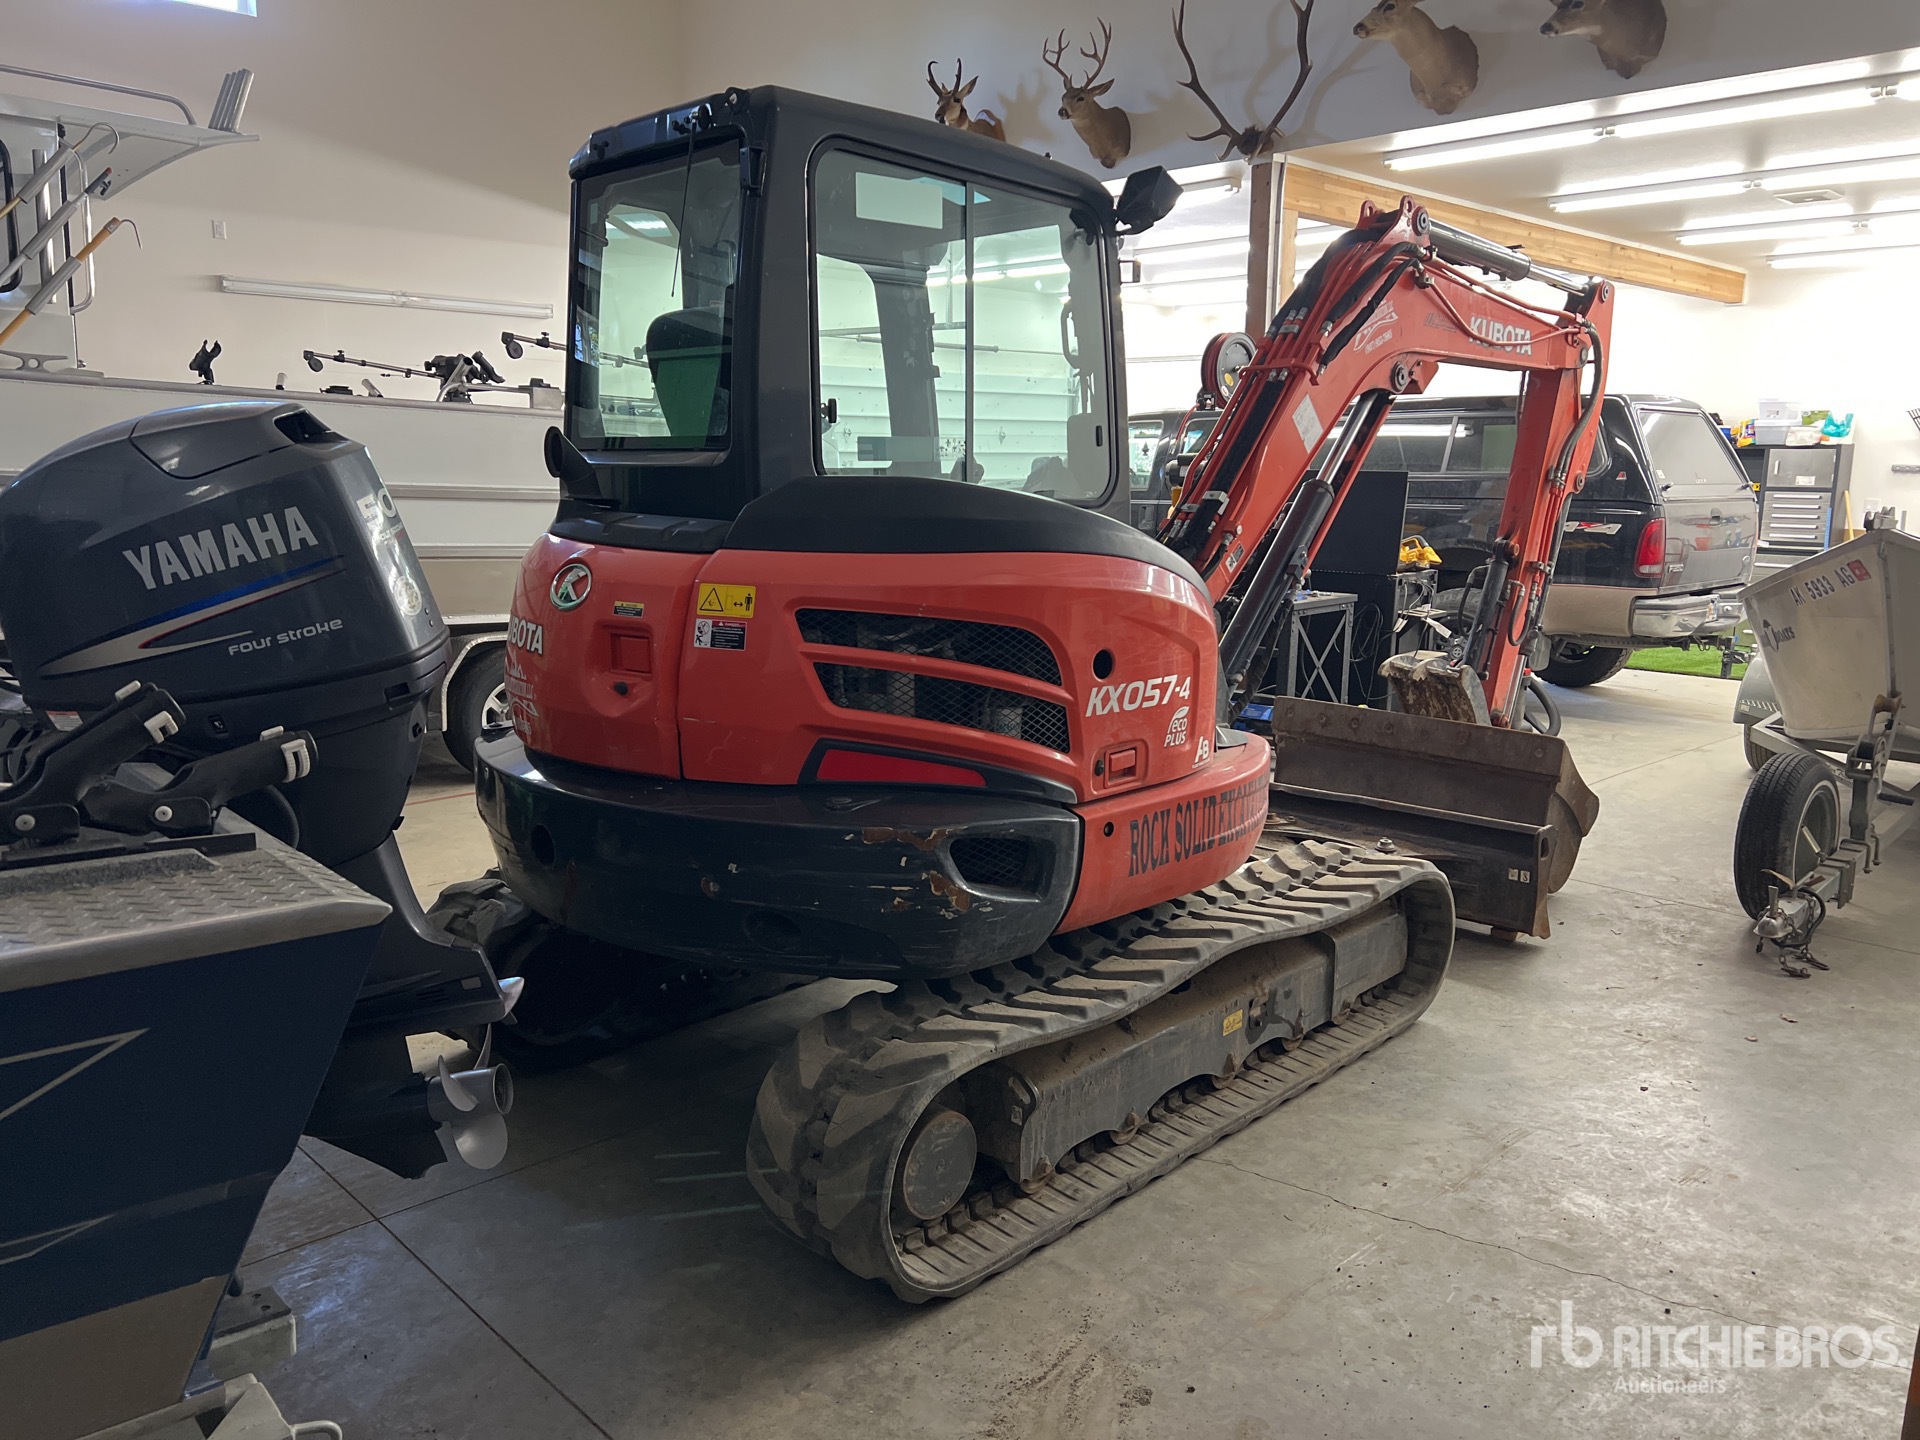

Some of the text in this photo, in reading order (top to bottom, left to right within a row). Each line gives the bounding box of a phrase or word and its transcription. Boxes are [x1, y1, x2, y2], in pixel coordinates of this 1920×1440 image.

[1468, 316, 1532, 355] KUBOTA
[122, 506, 318, 590] YAMAHA
[1789, 566, 1855, 606] AK 5933 AG
[1085, 674, 1191, 717] KX057-4
[1164, 731, 1186, 747] PLUS
[1128, 808, 1171, 878] ROCK
